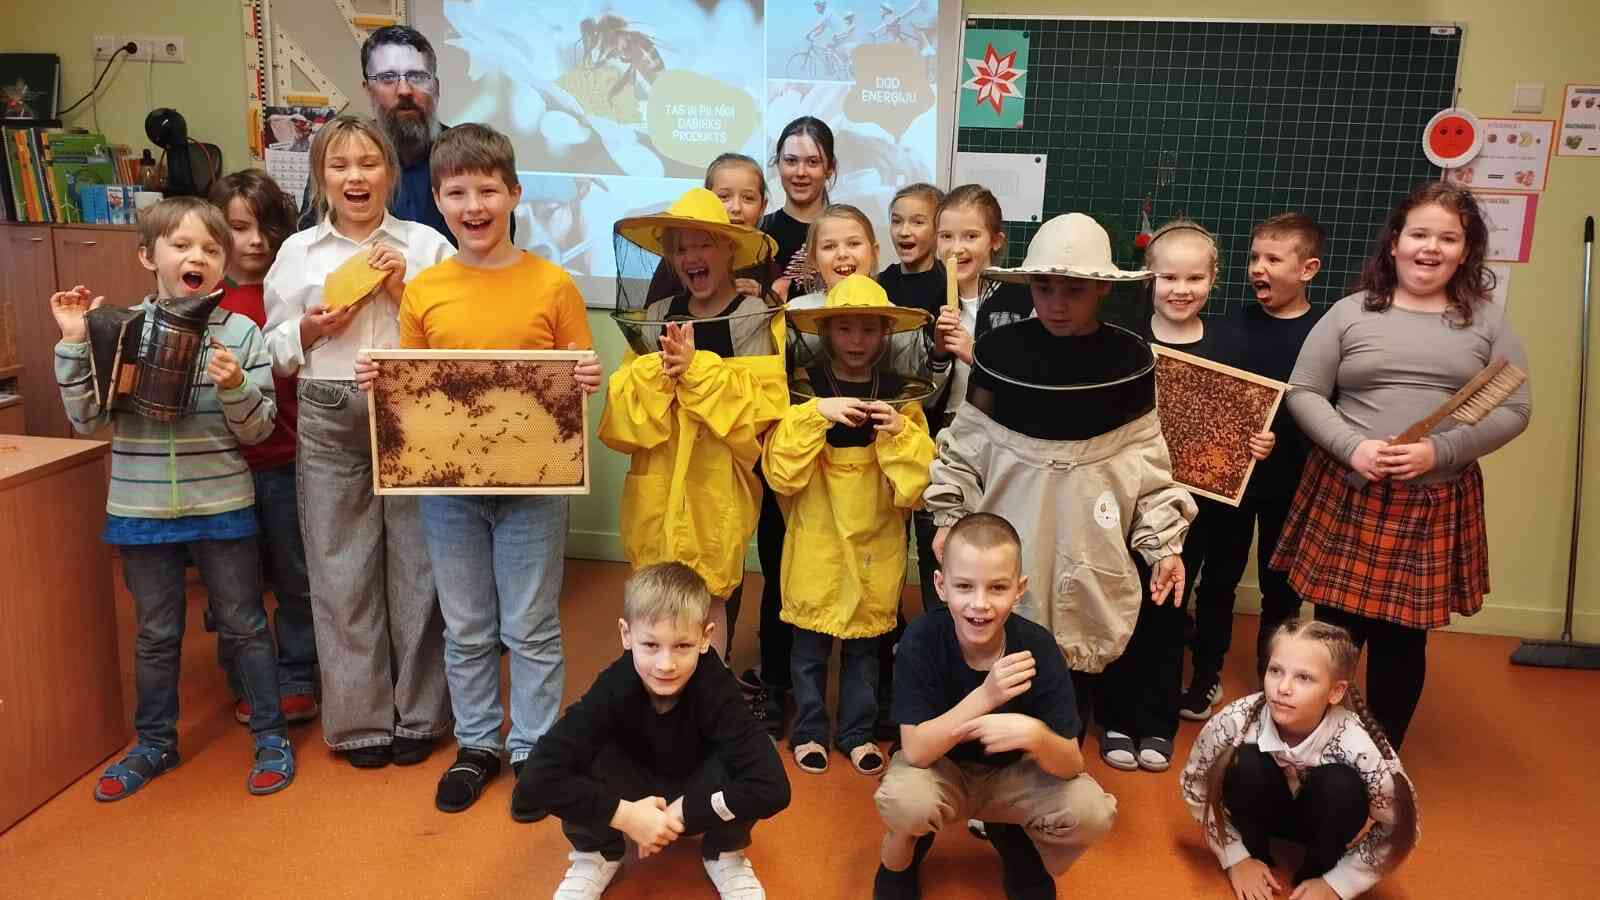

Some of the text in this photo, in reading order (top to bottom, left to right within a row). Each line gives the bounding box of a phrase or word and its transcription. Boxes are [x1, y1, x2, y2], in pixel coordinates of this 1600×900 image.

[875, 77, 901, 89] DOD
[664, 104, 686, 116] TAS
[672, 130, 728, 143] PRODUKTS
